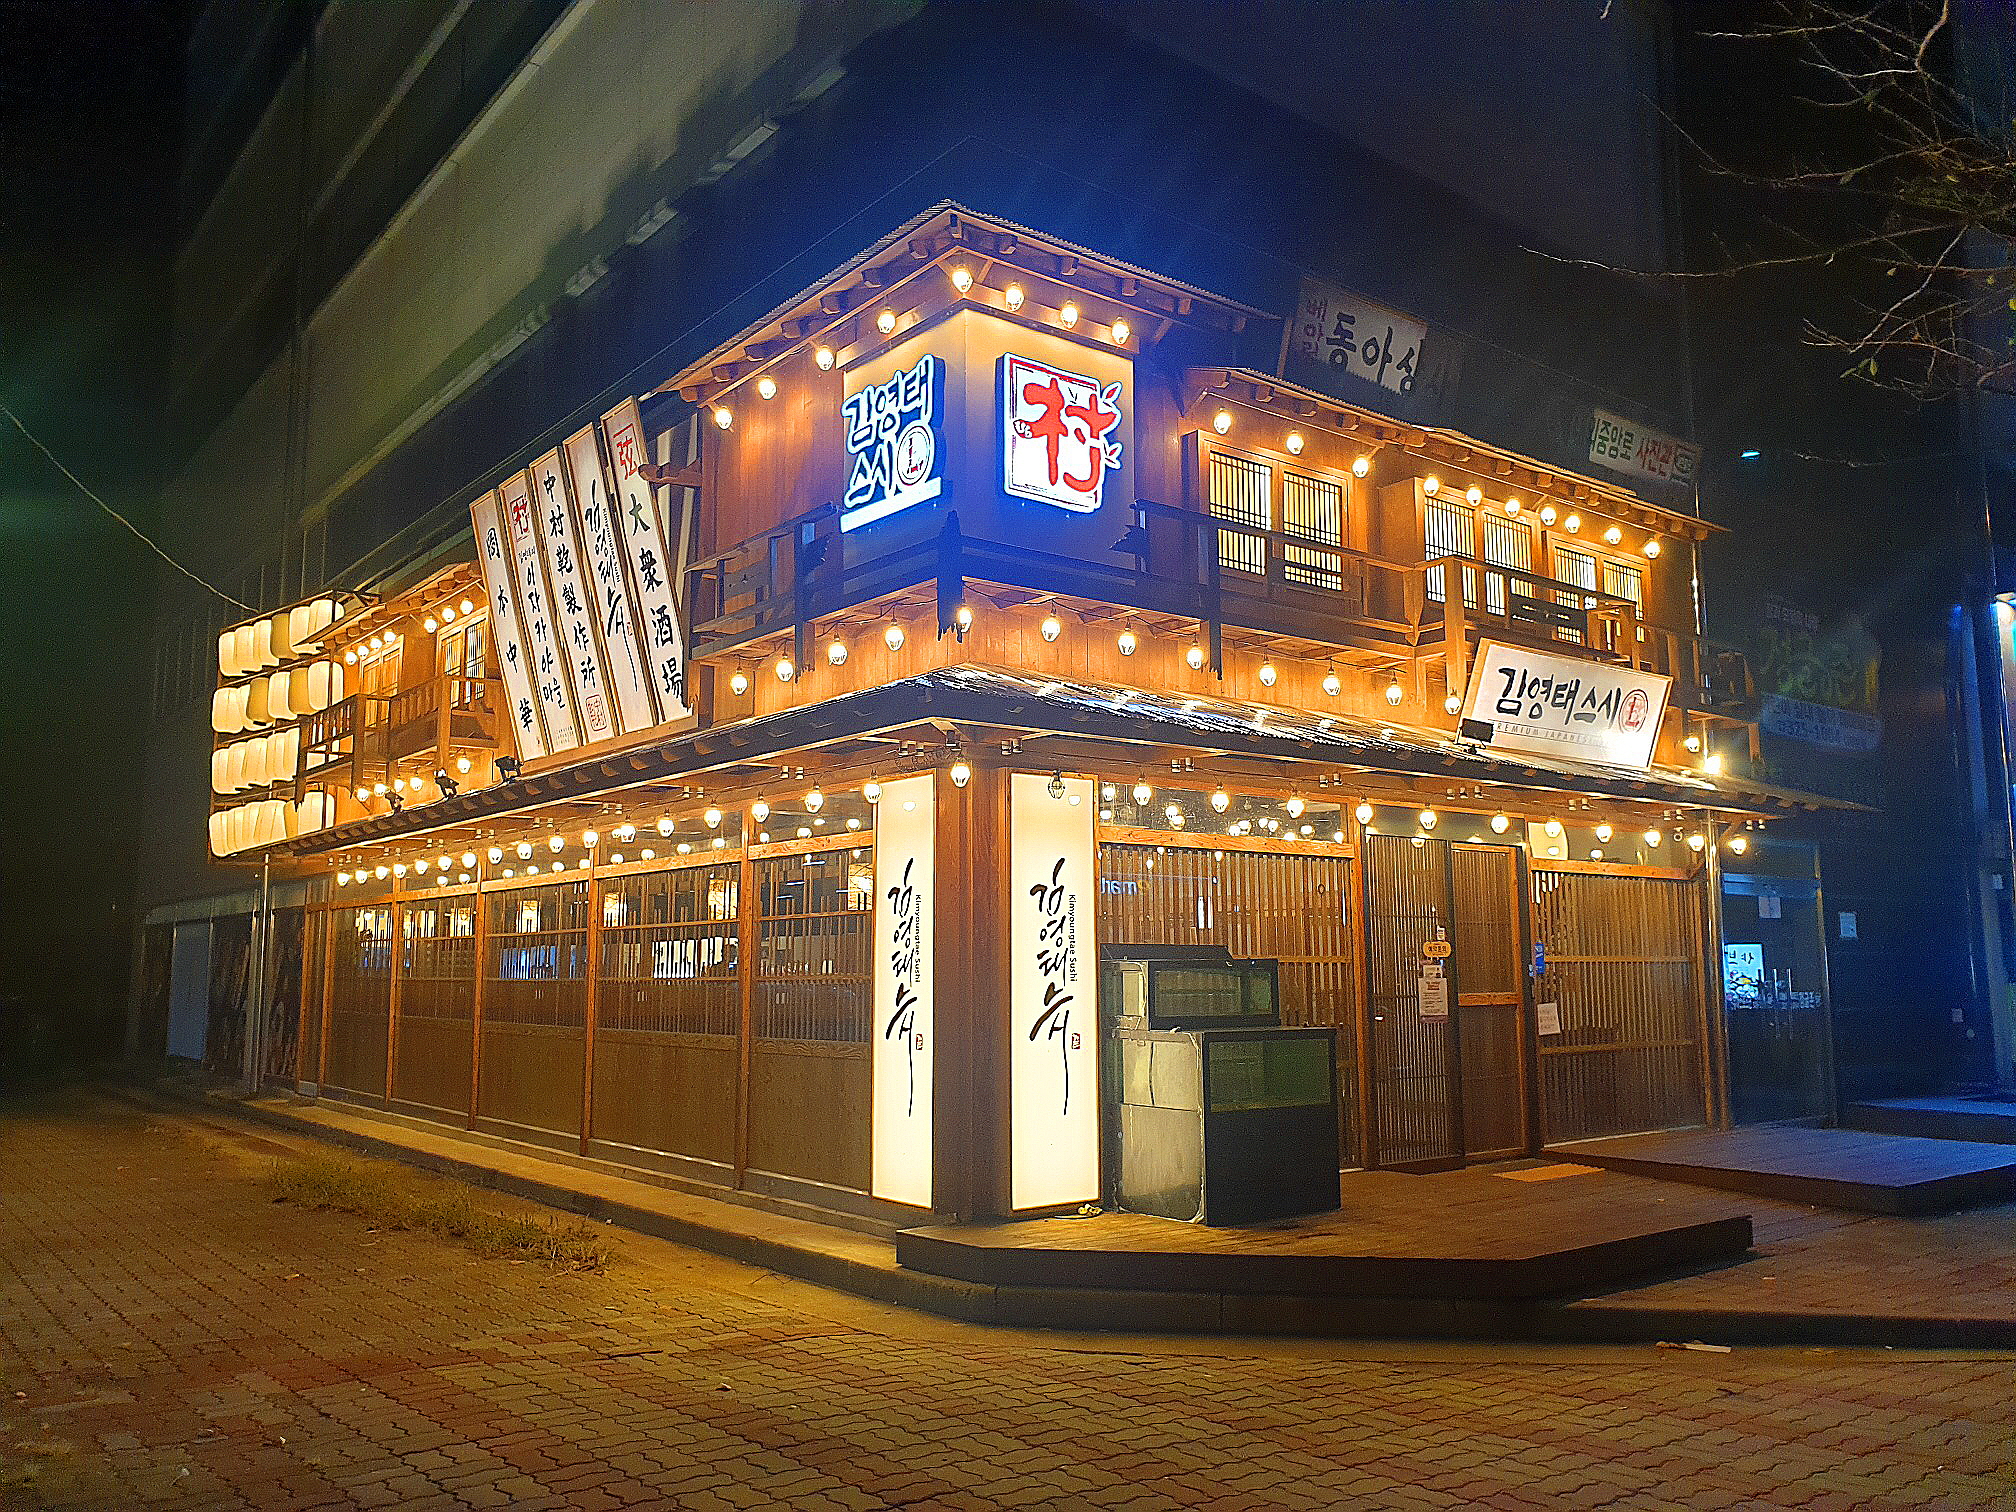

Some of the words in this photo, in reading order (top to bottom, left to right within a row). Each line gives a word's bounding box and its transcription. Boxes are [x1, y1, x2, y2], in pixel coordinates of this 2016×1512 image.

[844, 356, 932, 449] 김영태
[1596, 419, 1635, 461] 중앙로
[1496, 667, 1622, 730] 김영태스시
[1496, 722, 1540, 736] REMIUM
[1069, 894, 1077, 955] Kimyoungtae
[1070, 957, 1078, 982] Sushi
